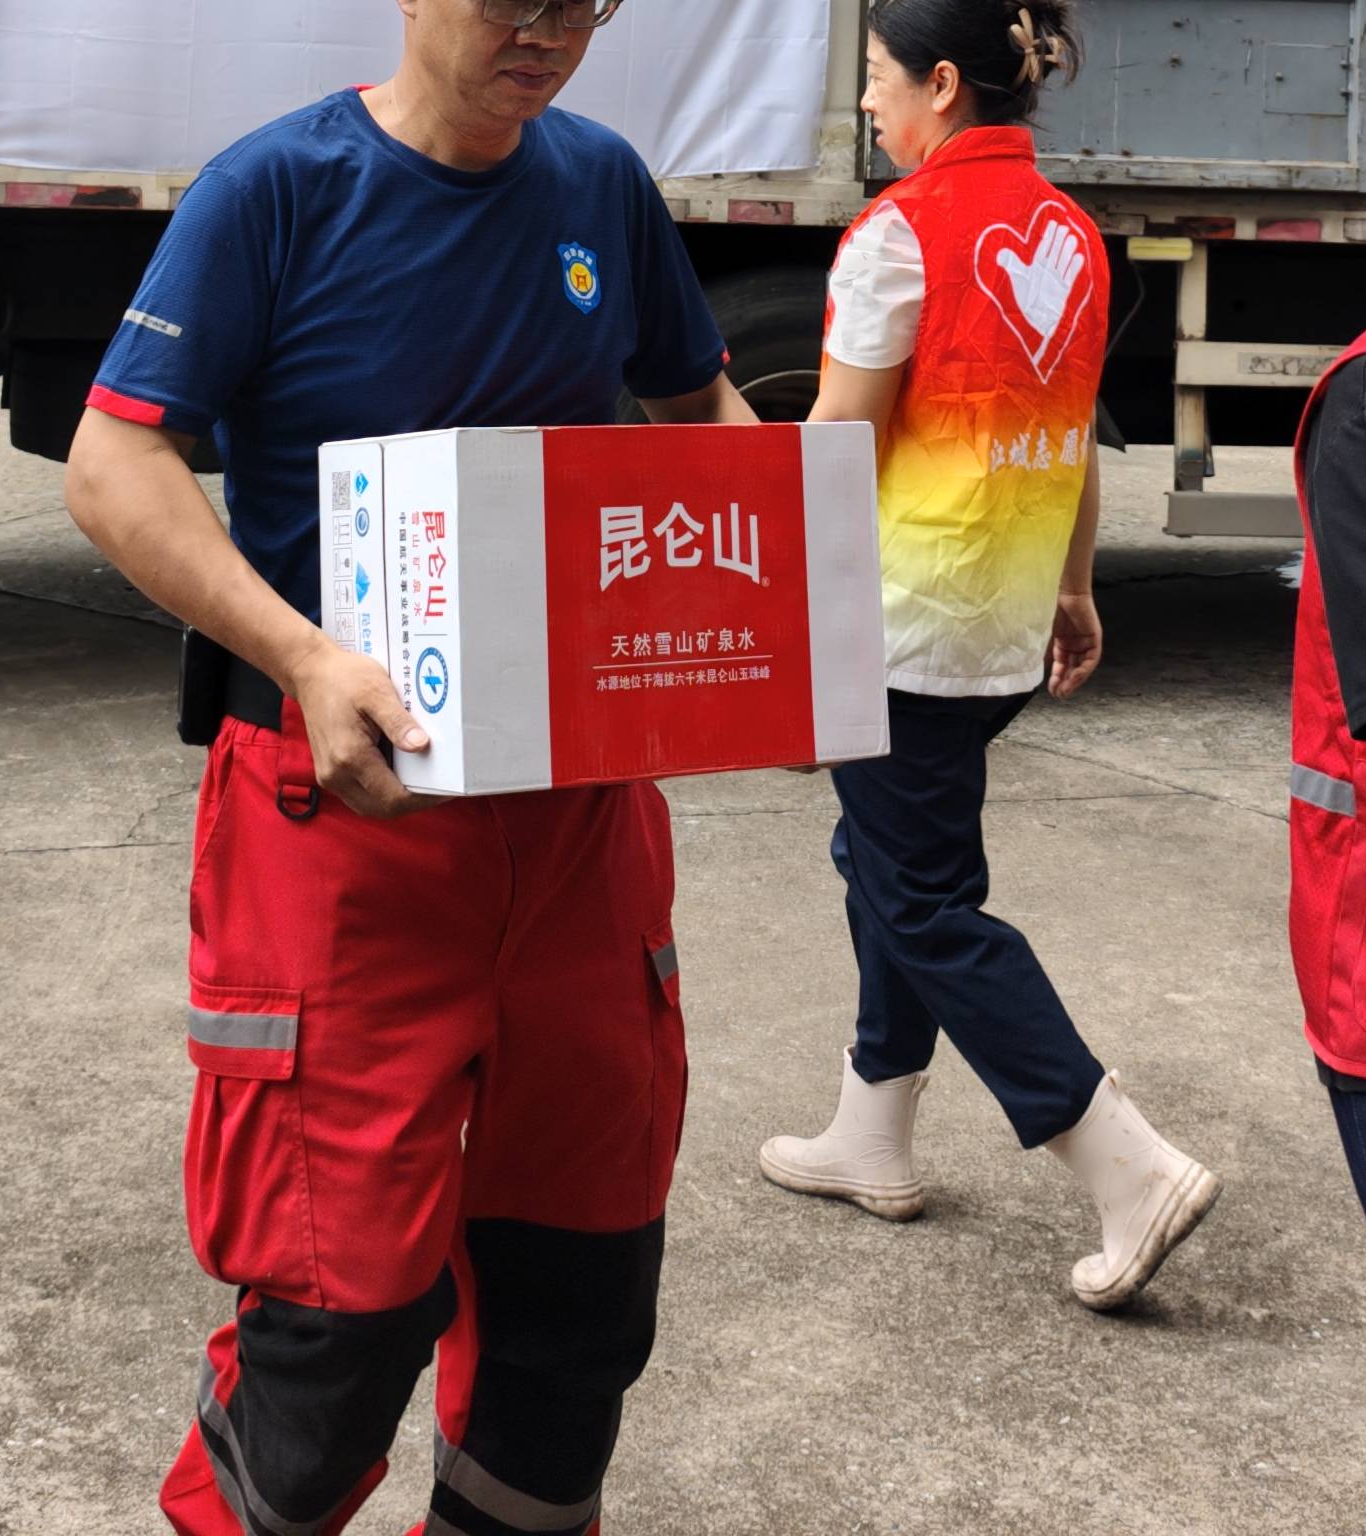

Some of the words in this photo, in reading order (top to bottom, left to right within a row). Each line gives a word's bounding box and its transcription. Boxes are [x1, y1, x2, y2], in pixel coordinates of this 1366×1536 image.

[421, 511, 447, 618] 昆仑山
[599, 501, 760, 592] 昆仑山
[611, 626, 756, 658] 天然雪山矿泉水
[596, 665, 771, 692] 水源地位于海拔六千米昆仑山玉珠峰
